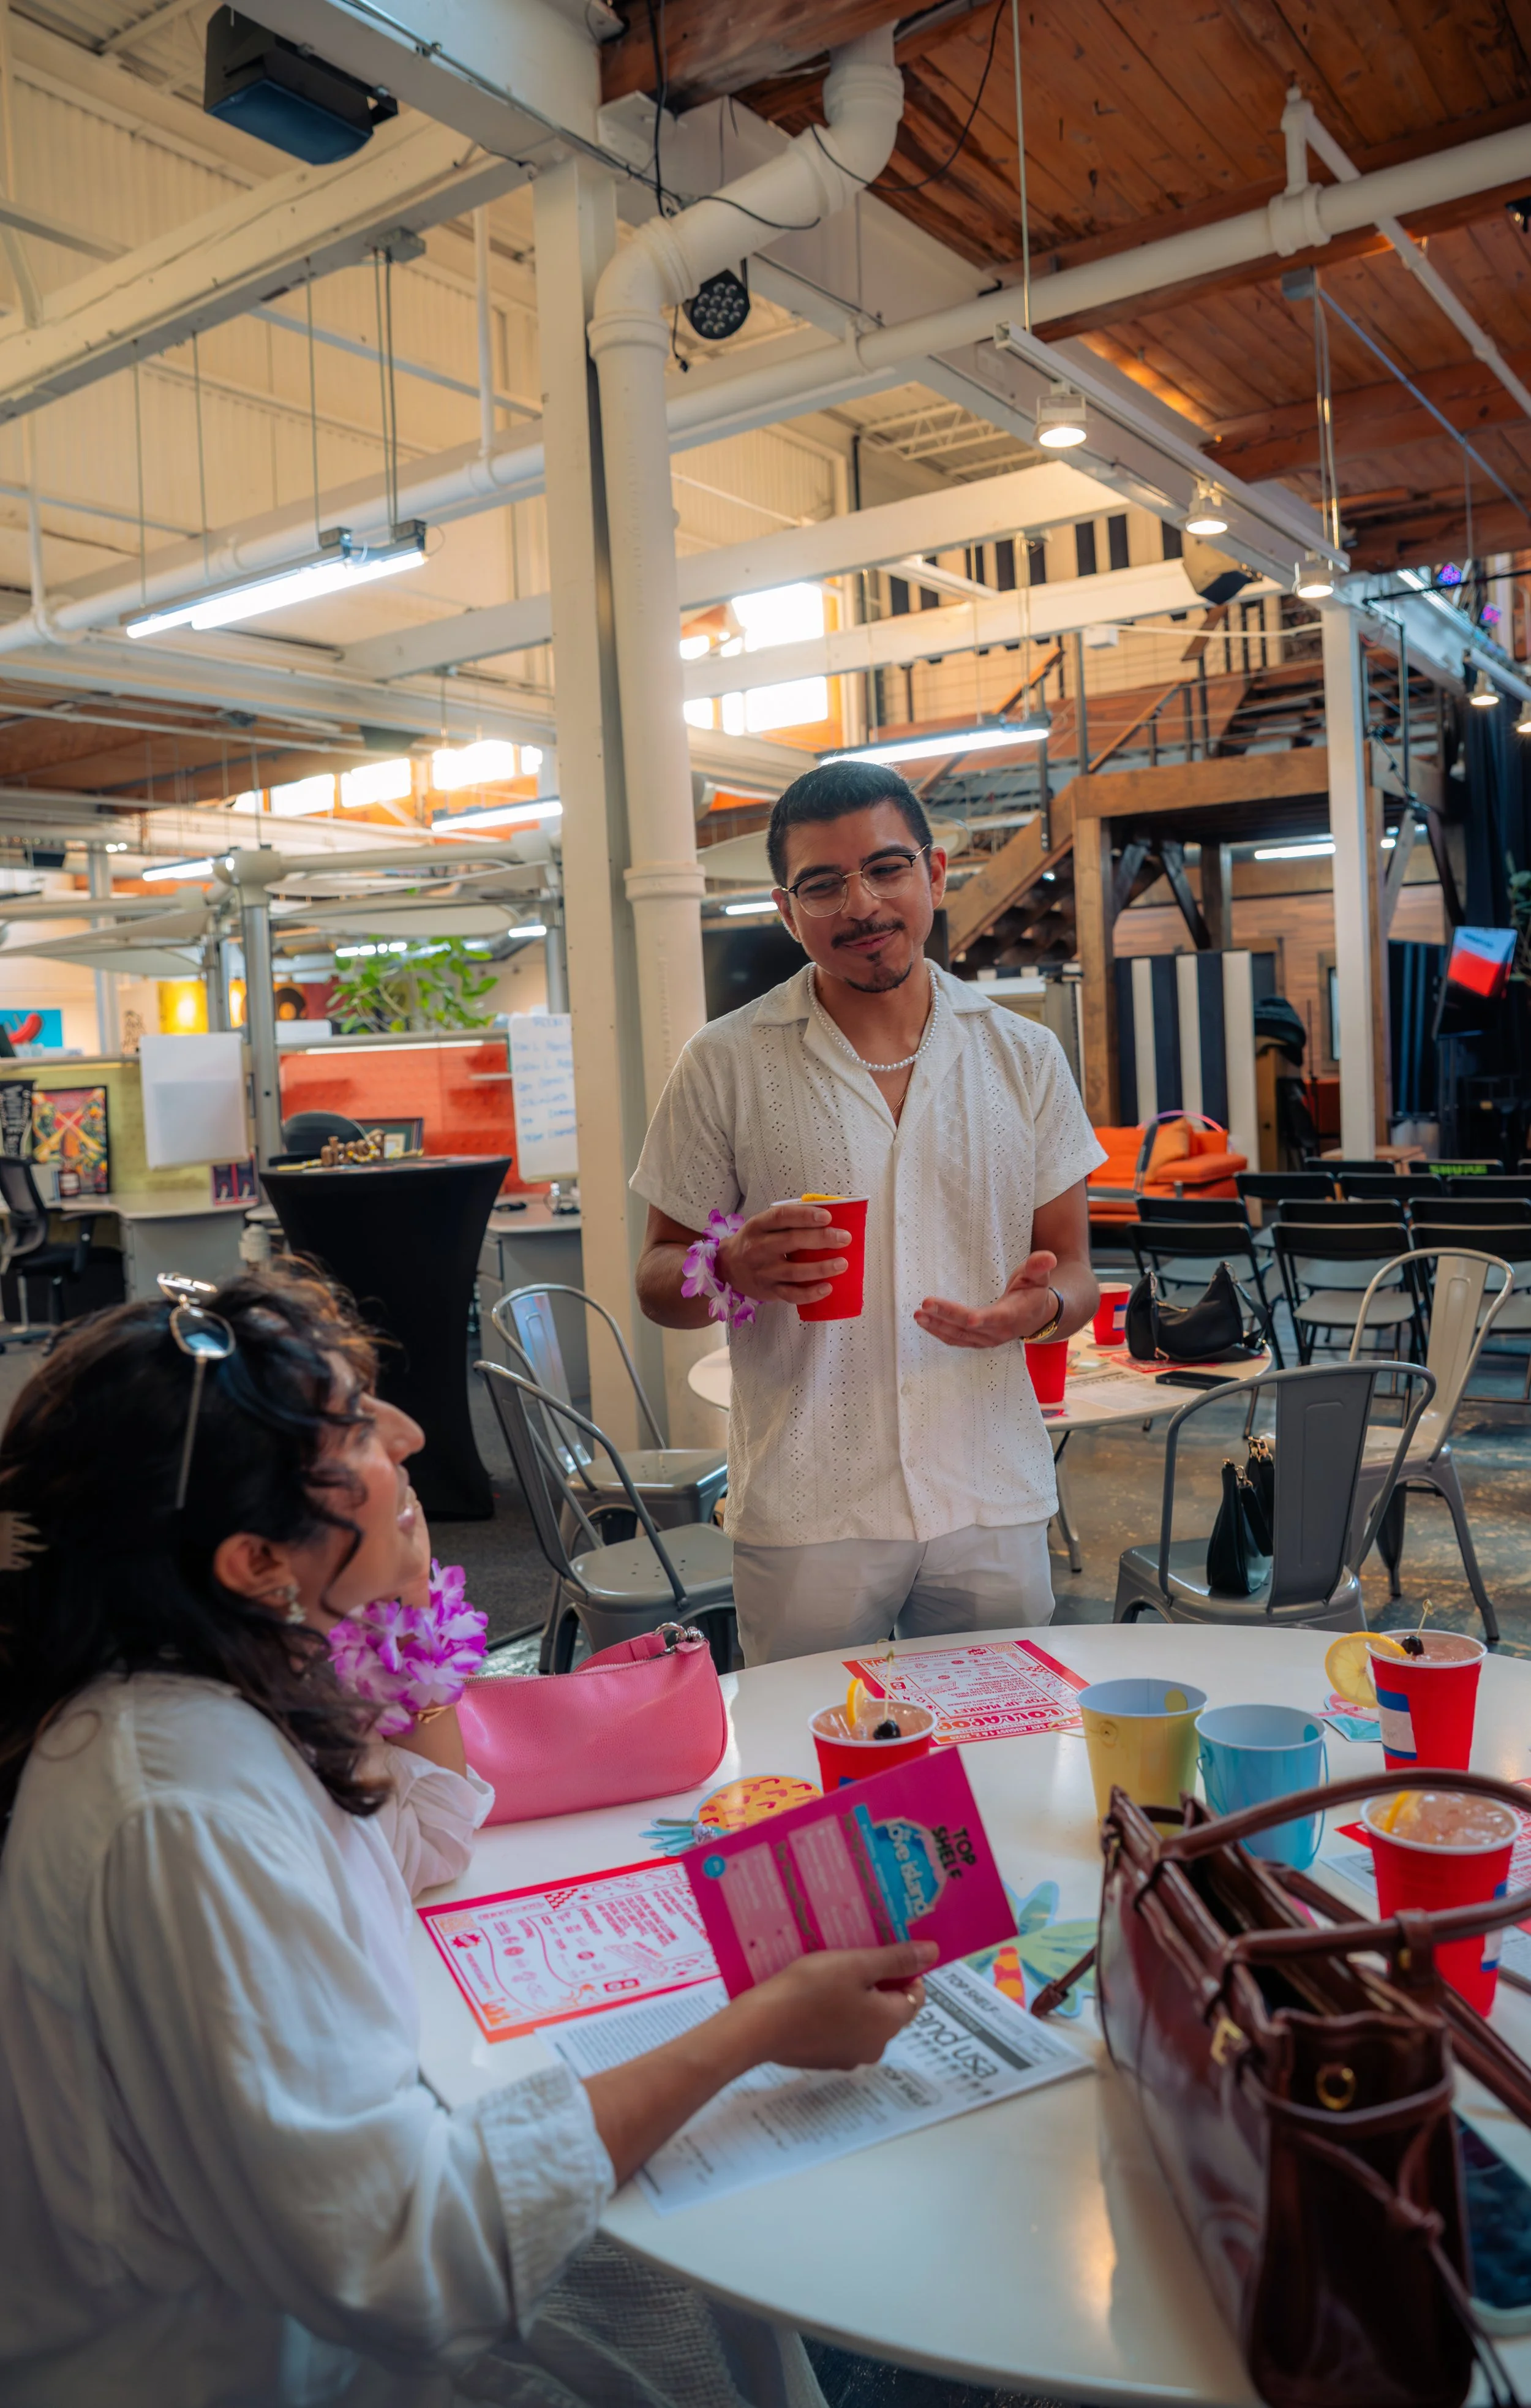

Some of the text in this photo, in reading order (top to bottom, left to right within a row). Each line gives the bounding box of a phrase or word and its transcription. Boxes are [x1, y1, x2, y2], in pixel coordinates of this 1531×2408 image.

[952, 1697, 1048, 1714] POP-UP MARKET
[995, 1726, 1027, 1735] AUGUST
[930, 1824, 963, 1882] SHELF
[950, 1825, 979, 1868] TOP
[943, 1971, 969, 1991] TOP
[962, 1986, 1001, 2015] SHELF
[951, 2040, 1000, 2083] usa
